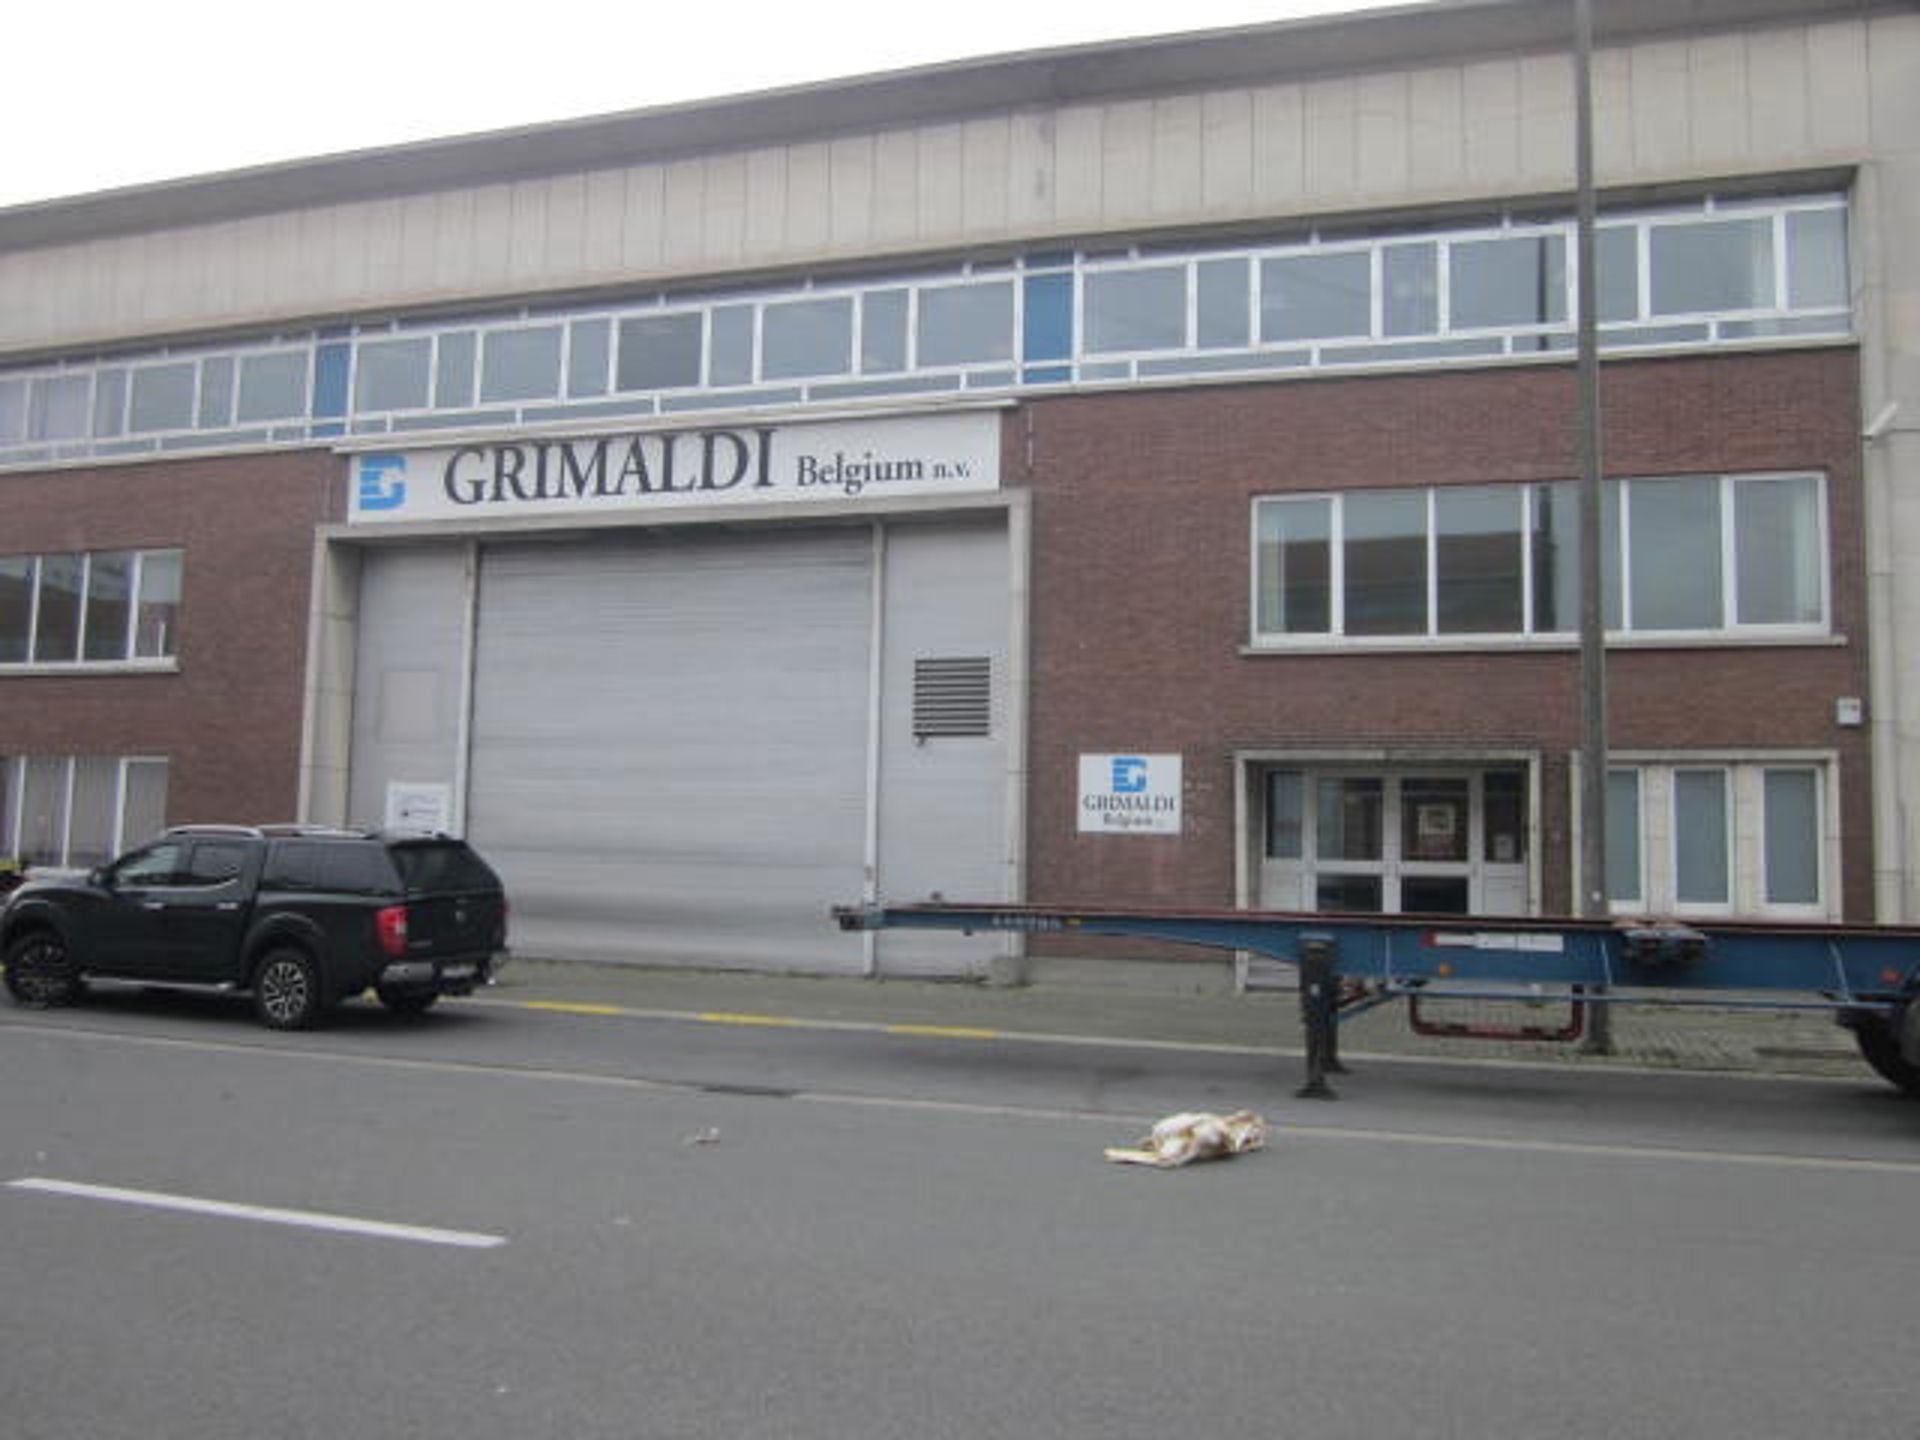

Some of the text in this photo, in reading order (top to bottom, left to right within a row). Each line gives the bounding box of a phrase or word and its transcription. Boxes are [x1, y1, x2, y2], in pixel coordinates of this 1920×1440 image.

[443, 429, 777, 505] GRIMALDI
[797, 451, 923, 495] Belgium
[1082, 794, 1175, 812] GRIMALDI
